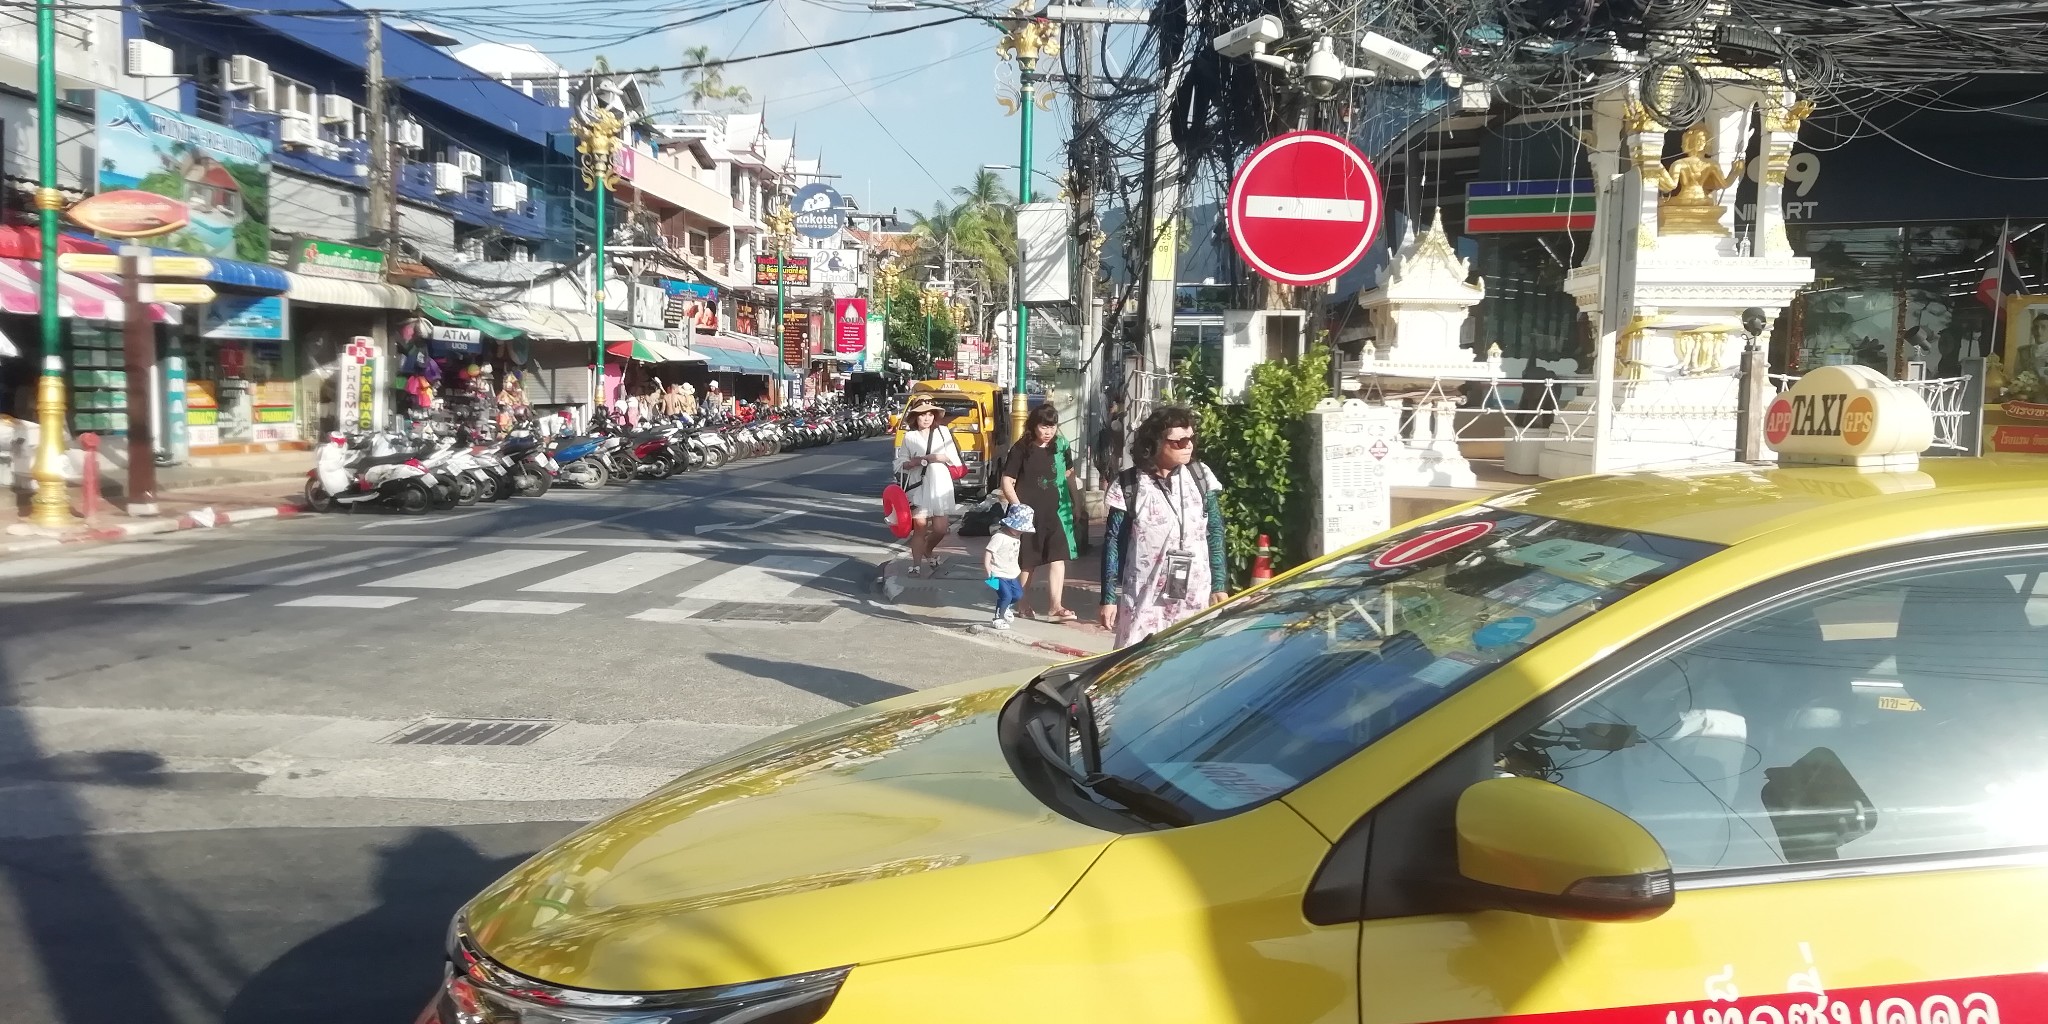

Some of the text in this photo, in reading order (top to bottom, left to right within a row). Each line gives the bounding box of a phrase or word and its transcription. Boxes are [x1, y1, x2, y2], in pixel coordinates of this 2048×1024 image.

[796, 212, 838, 224] kokotel
[442, 329, 471, 341] ATM
[451, 342, 468, 350] UOB
[360, 365, 373, 429] PHARMAC
[1766, 394, 1873, 436] APP TAXI GPS
